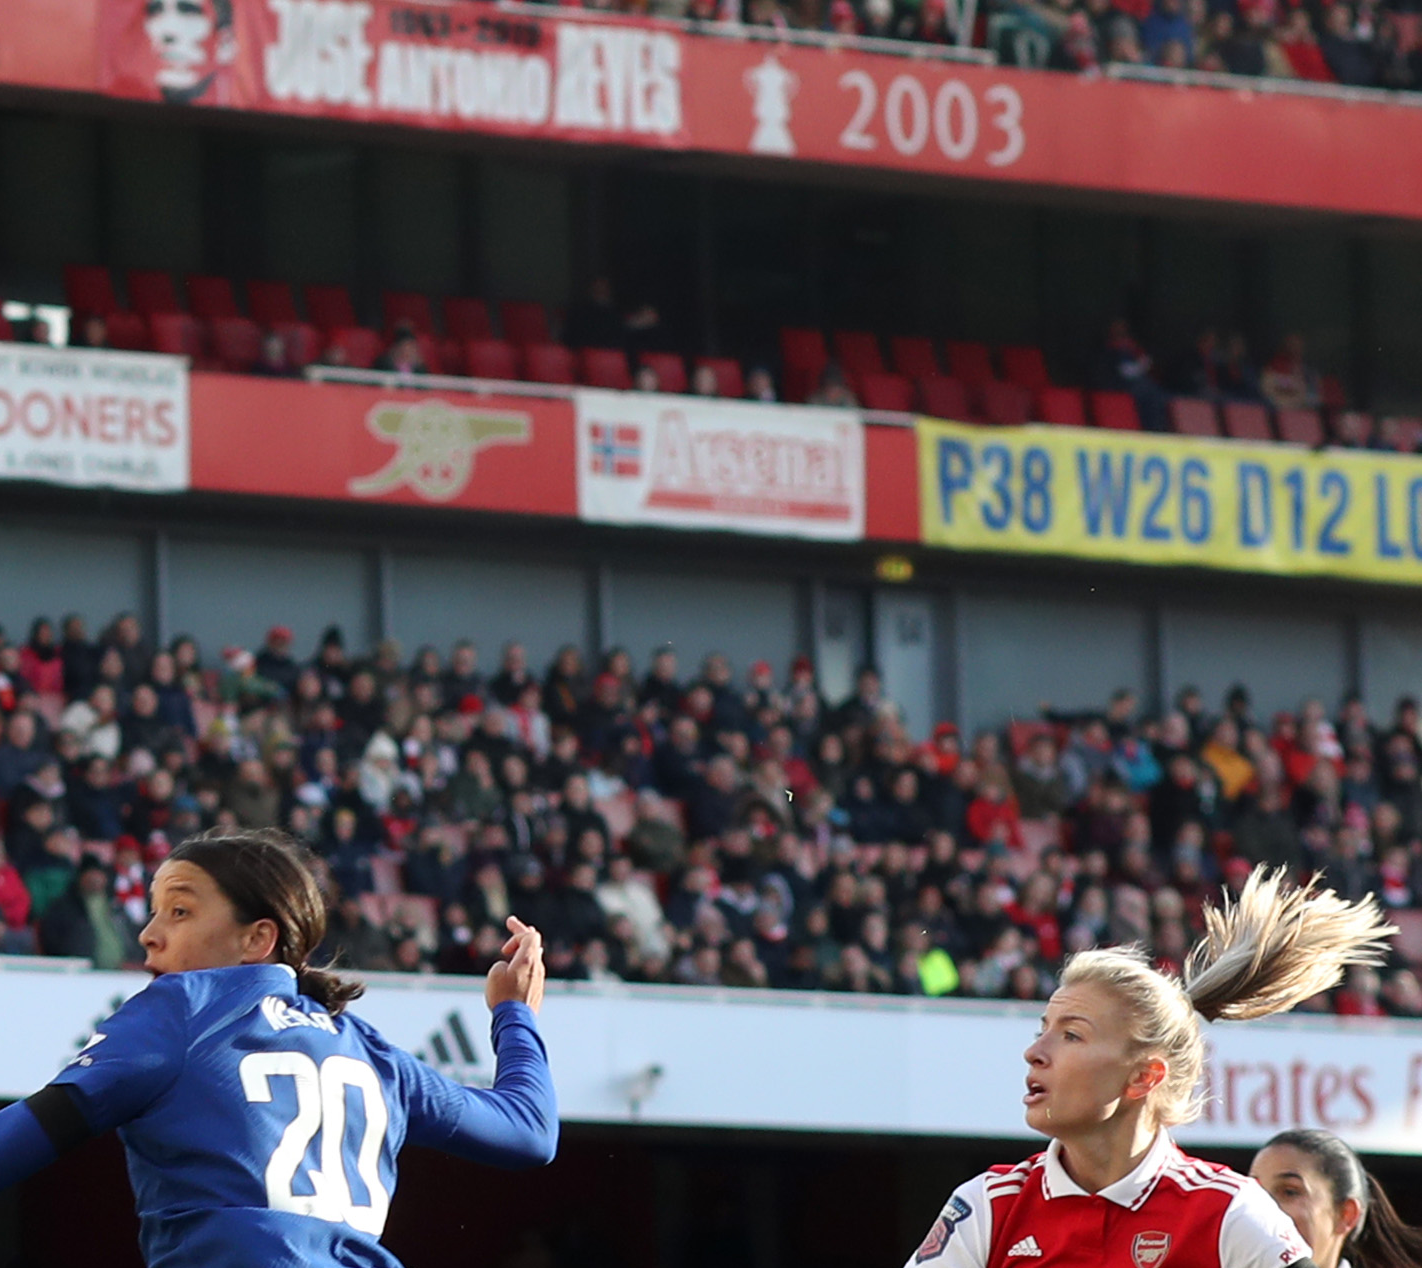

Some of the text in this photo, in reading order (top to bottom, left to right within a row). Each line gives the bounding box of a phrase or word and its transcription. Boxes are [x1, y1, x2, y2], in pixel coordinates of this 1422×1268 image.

[378, 41, 553, 126] ANTONIO
[555, 24, 682, 134] REYES
[838, 69, 1026, 167] 2003
[657, 409, 850, 494] Arsenal
[936, 436, 1053, 534] P38
[1076, 448, 1212, 545] W26
[1238, 460, 1352, 555] D12
[238, 1051, 390, 1236] 20
